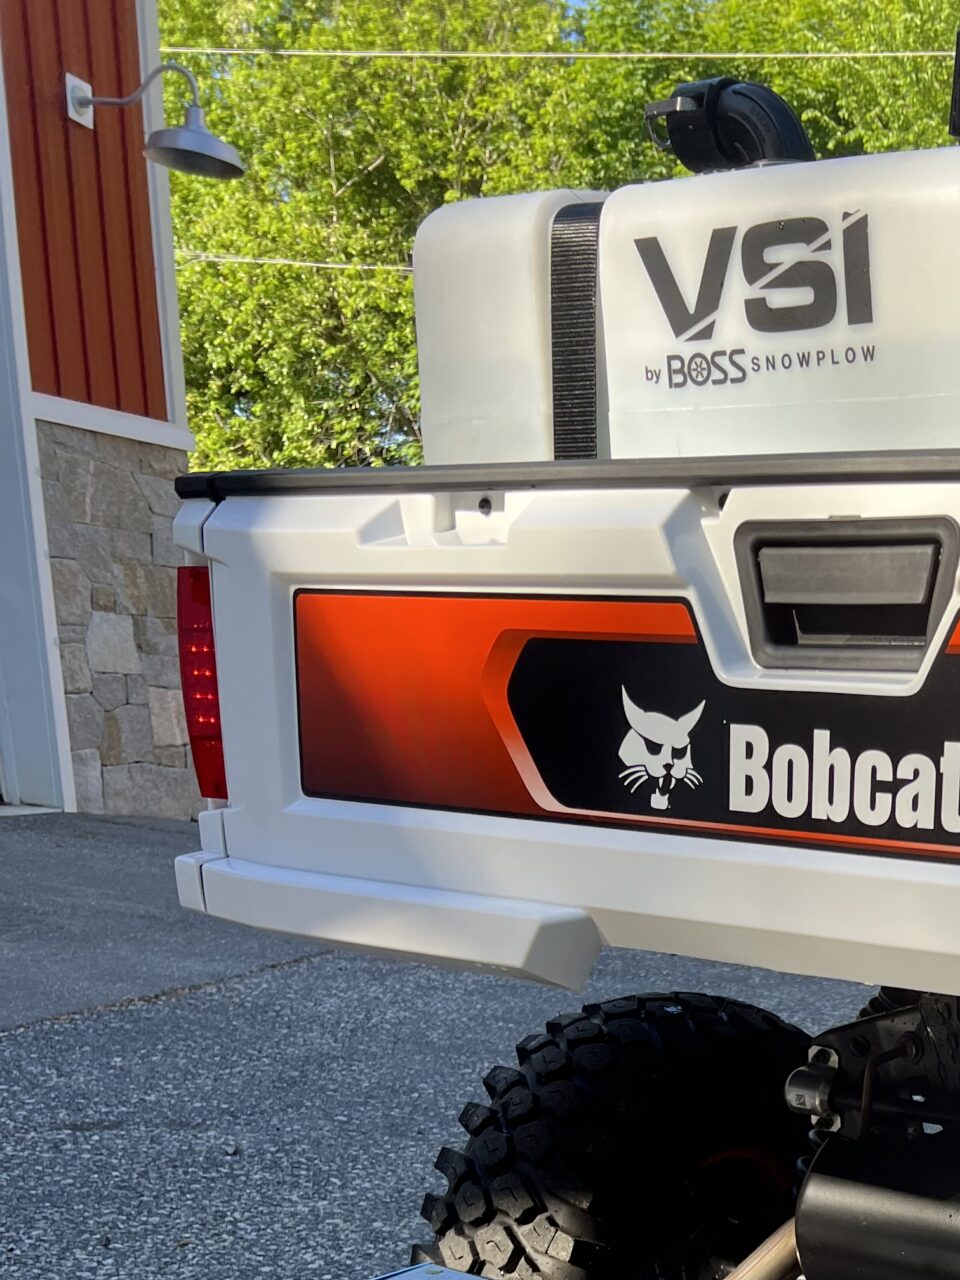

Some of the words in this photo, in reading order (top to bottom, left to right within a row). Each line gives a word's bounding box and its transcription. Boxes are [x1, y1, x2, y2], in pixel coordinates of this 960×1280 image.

[645, 366, 662, 383] by
[666, 348, 747, 389] BOSS
[751, 345, 876, 372] SNOWPLOW
